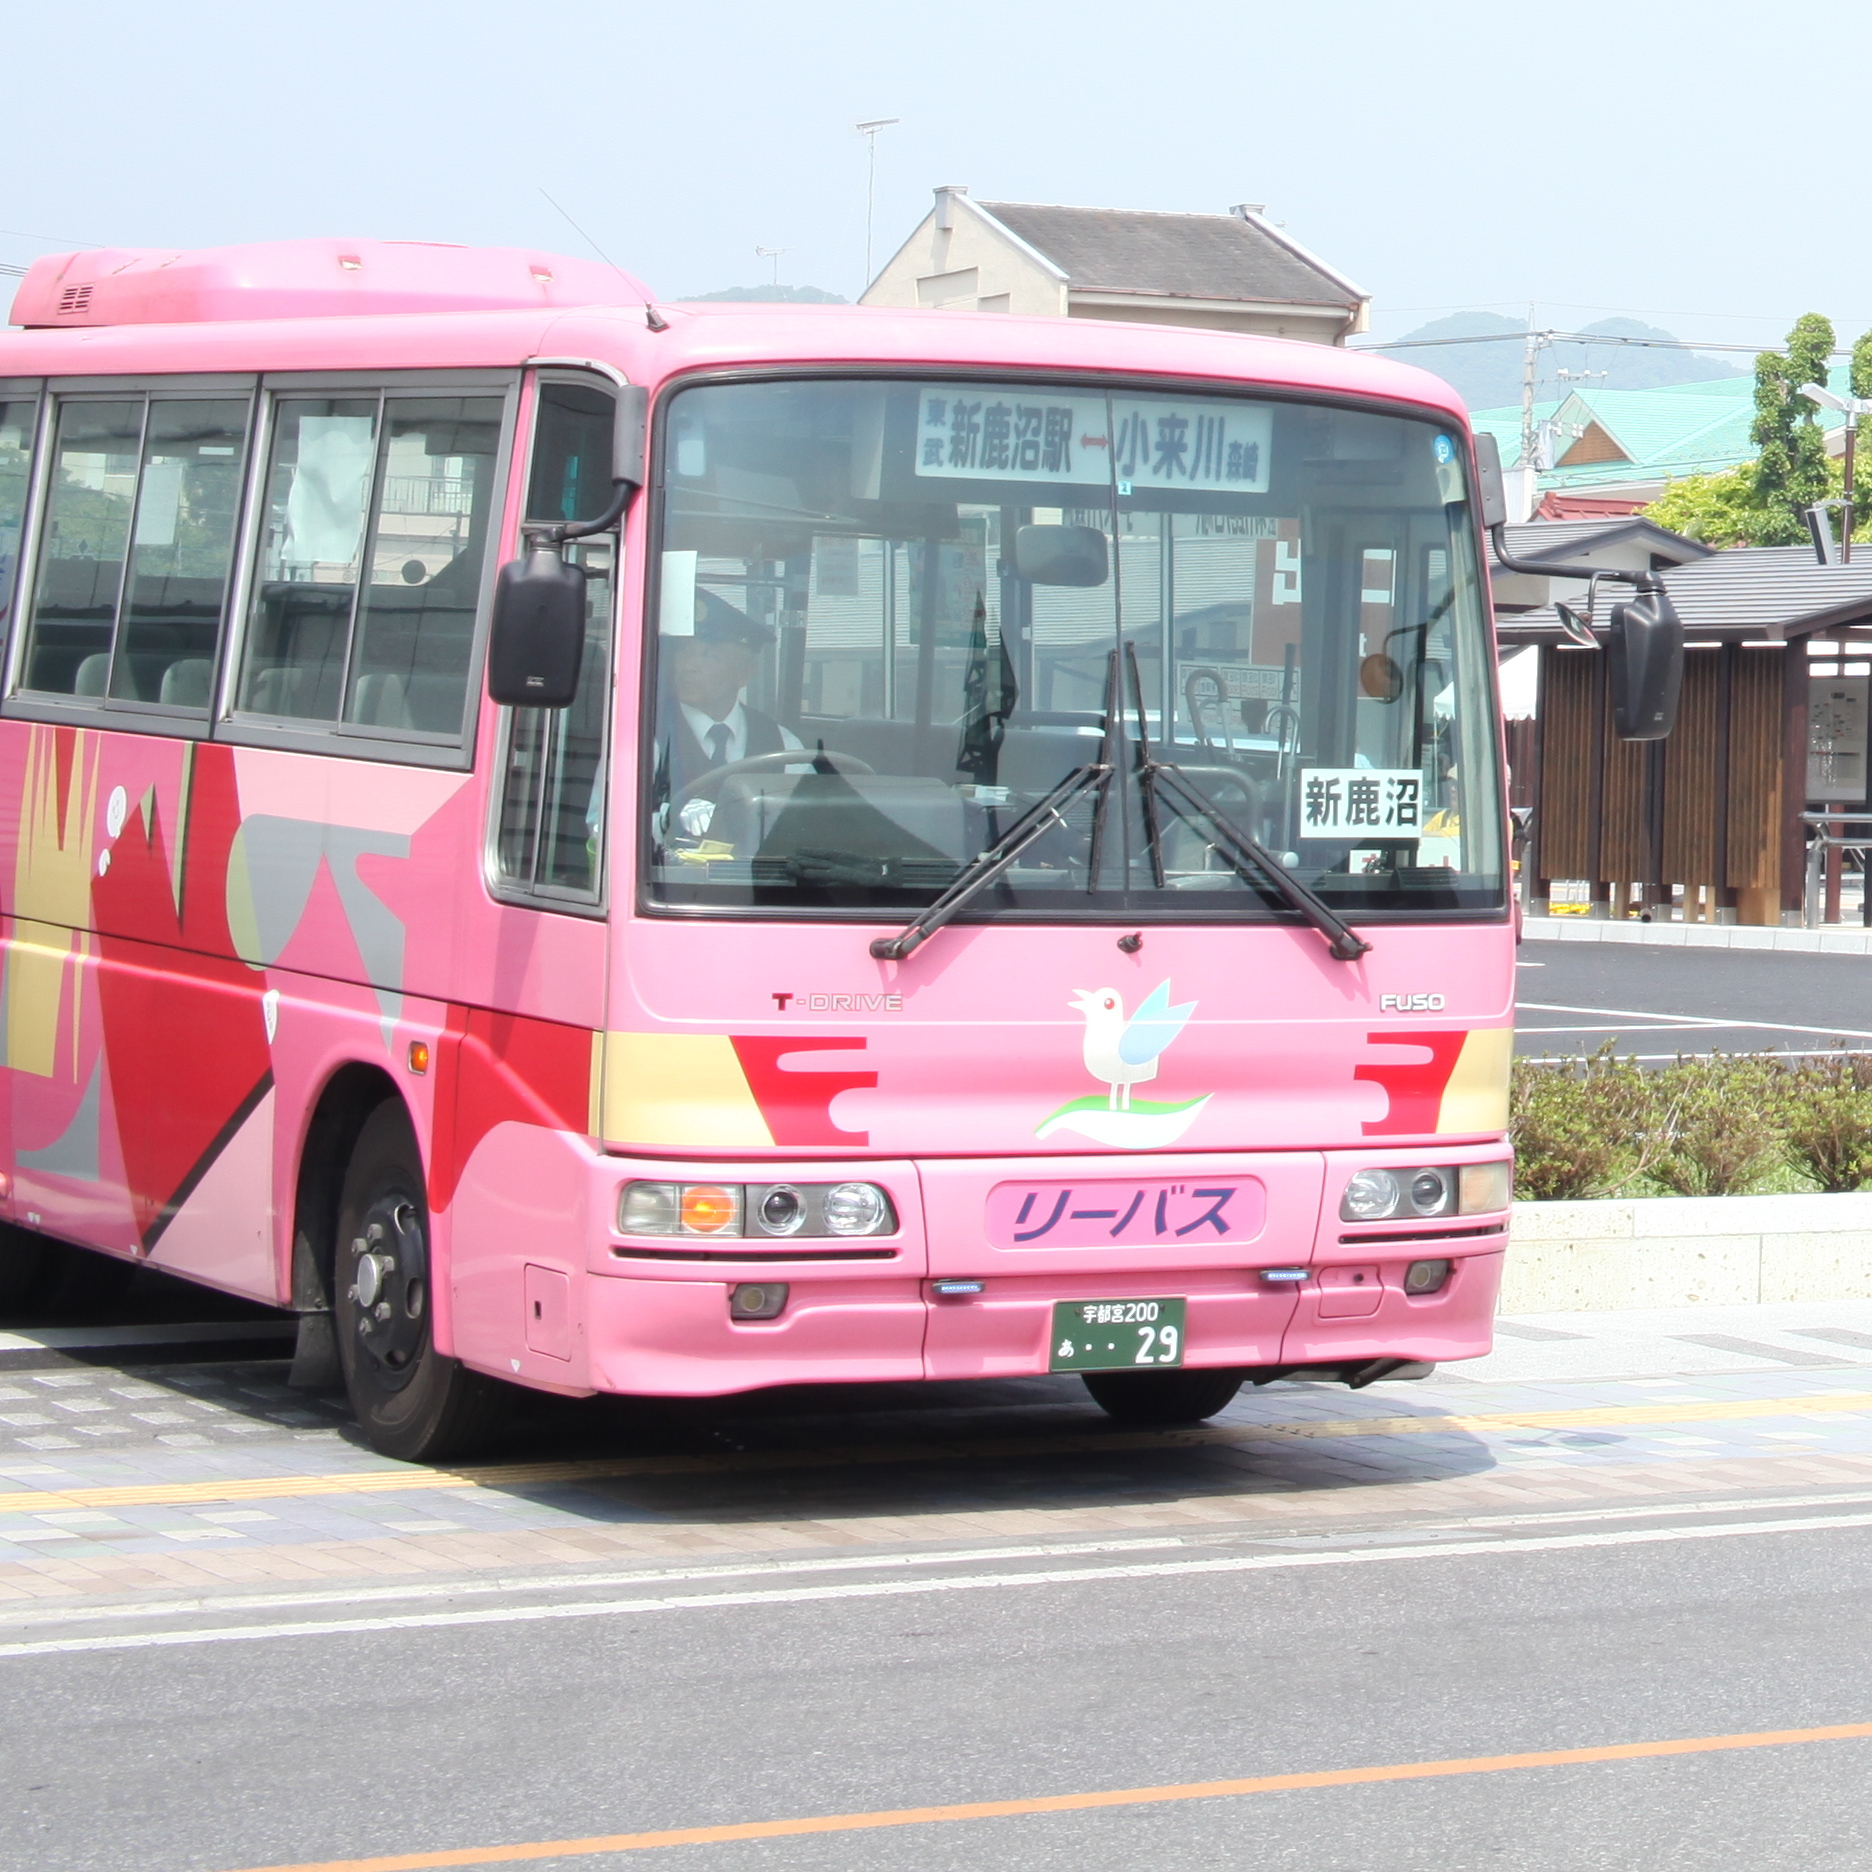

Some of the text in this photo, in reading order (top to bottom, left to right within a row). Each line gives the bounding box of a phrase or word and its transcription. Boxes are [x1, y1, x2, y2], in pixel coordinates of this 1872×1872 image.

[923, 397, 948, 468] 東武
[949, 398, 1073, 473] 新鹿沼駅
[1115, 411, 1225, 482] 小来川
[1305, 776, 1419, 827] 新鹿沼
[771, 992, 904, 1012] T-DRIVE
[1379, 992, 1446, 1013] FUSO
[1013, 1184, 1239, 1242] リーバス
